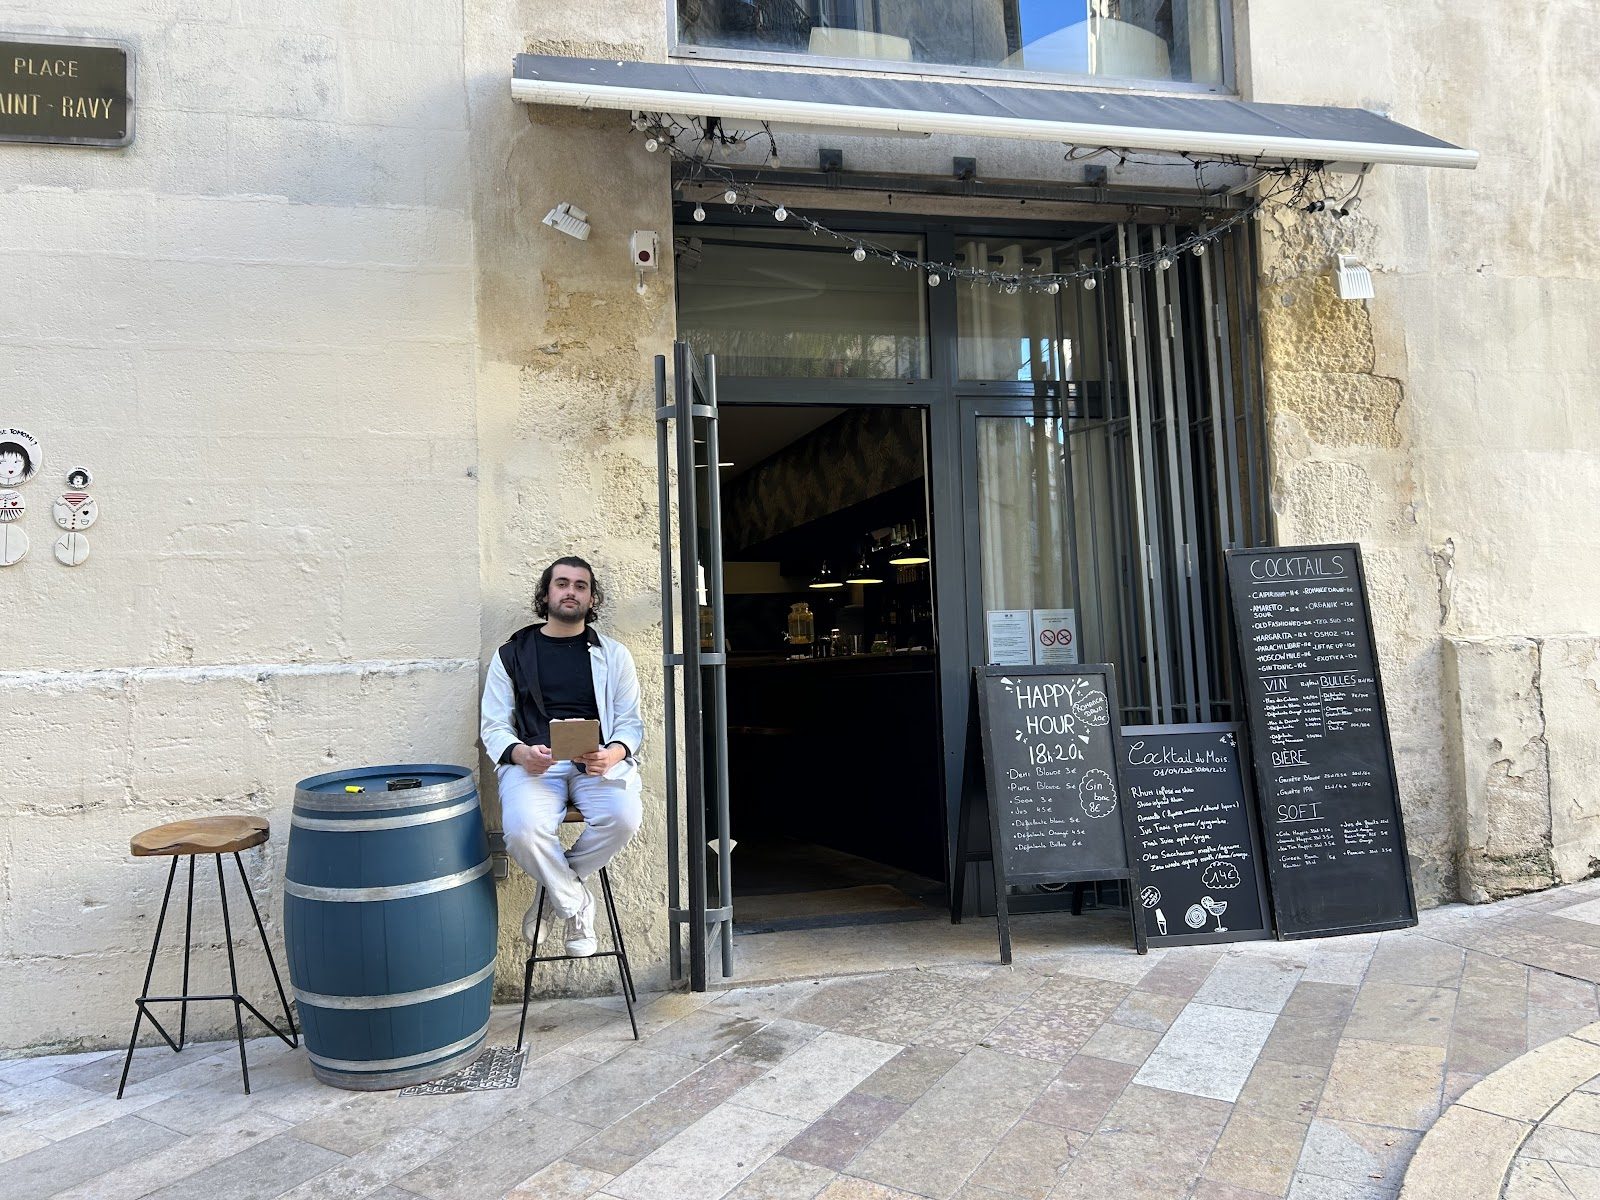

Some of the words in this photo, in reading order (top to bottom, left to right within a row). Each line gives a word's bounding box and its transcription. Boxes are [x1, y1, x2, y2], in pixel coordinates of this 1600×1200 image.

[14, 57, 79, 78] PLACE
[62, 95, 113, 119] RAVY
[1250, 555, 1344, 580] COCKTAILS
[1253, 603, 1283, 612] AMARETTO
[1308, 601, 1338, 610] ORGANIK
[1256, 632, 1293, 642] MARGARITA
[1258, 652, 1286, 662] MOSCOW
[1263, 678, 1288, 691] VIN
[1320, 674, 1357, 687] BULLES
[1016, 683, 1077, 710] HAPPY
[1026, 713, 1076, 735] HOUR
[1128, 740, 1195, 766] Cocktail
[1195, 752, 1205, 764] du
[1271, 748, 1308, 766] BIÈRE
[1065, 767, 1077, 775] 3€
[1085, 778, 1103, 791] Gin
[1303, 785, 1314, 793] IPA
[1131, 785, 1154, 798] Rhum
[1088, 802, 1101, 813] 8€
[1277, 801, 1322, 820] SOFT
[1209, 869, 1236, 884] 14€
